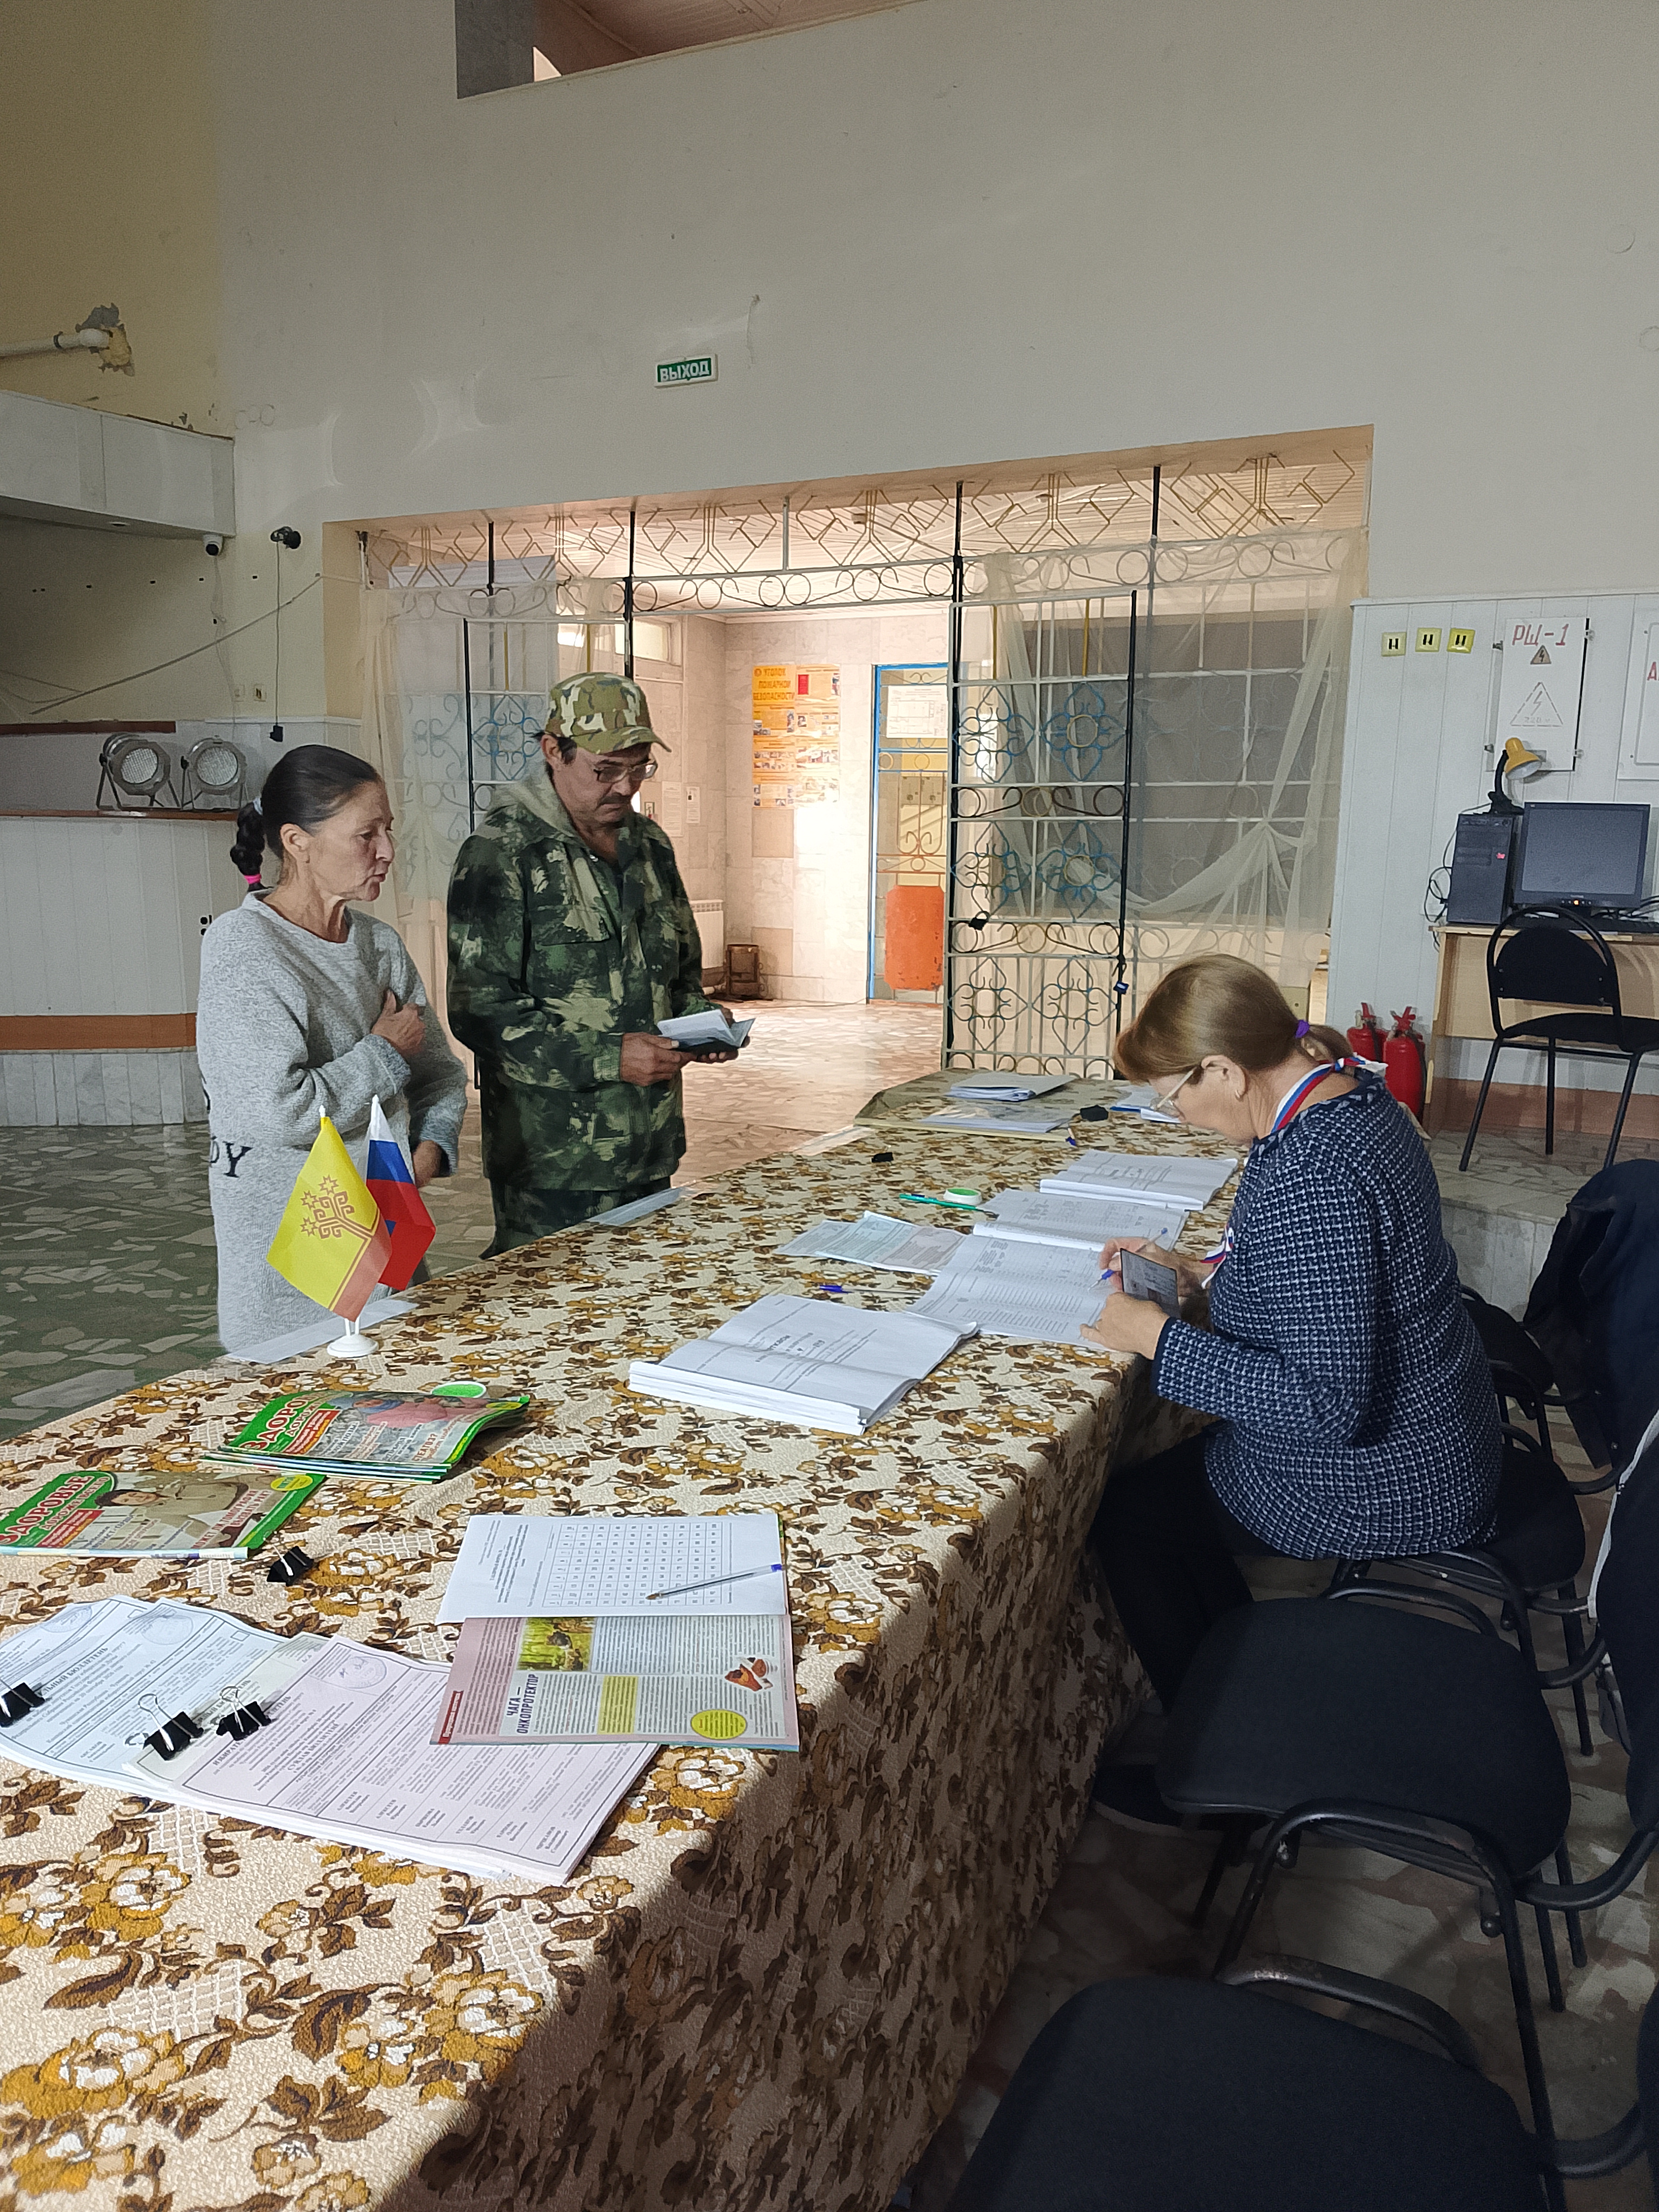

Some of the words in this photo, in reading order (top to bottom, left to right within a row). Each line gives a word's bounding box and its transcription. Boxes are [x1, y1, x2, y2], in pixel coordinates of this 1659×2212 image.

[660, 361, 710, 382] ВЫХОД
[764, 667, 786, 676] УГОЛОК
[1647, 661, 1659, 681] А
[758, 680, 791, 689] ПОЖАРНОЙ
[753, 692, 795, 701] БЕЗОПАСНОСТИ
[39, 1500, 84, 1530] ДОРОЖЕ
[77, 1477, 110, 1499] ВСЕГО
[221, 1490, 258, 1523] ТОМОГРАФИЯ
[231, 1503, 259, 1526] ВЫЗВАТЬ
[254, 1490, 272, 1506] РАК?
[507, 1697, 521, 1716] ЧАГА
[516, 1674, 539, 1734] ОНКОПРОТЕКТОР
